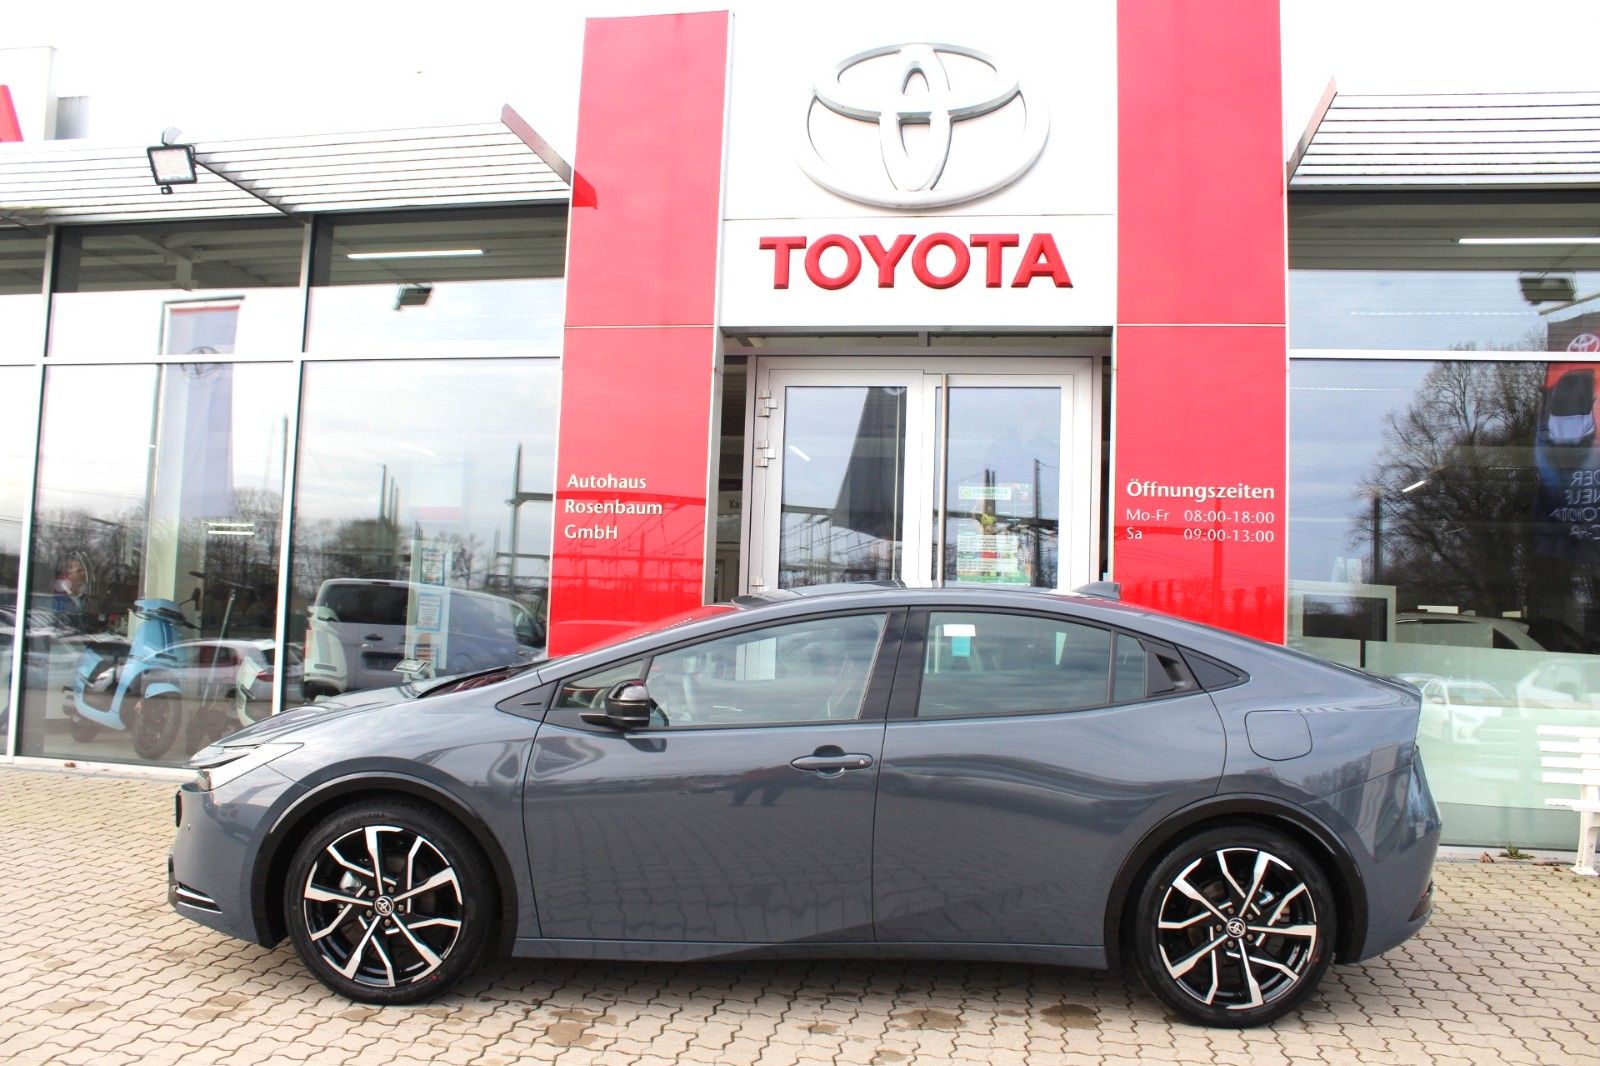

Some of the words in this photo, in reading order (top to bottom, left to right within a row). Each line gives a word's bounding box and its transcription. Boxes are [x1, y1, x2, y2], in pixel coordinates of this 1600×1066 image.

[759, 232, 1073, 290] TOYOTA
[567, 473, 647, 488] Autohaus
[1126, 478, 1275, 502] Öffnungszeiten
[565, 499, 662, 515] Rosenbaum
[1126, 508, 1169, 521] Mo-Fr
[1184, 509, 1275, 523] 08:00-18:00
[564, 524, 618, 539] GmbH
[1126, 527, 1143, 539] Sa
[1184, 528, 1275, 542] 09:00-13:00
